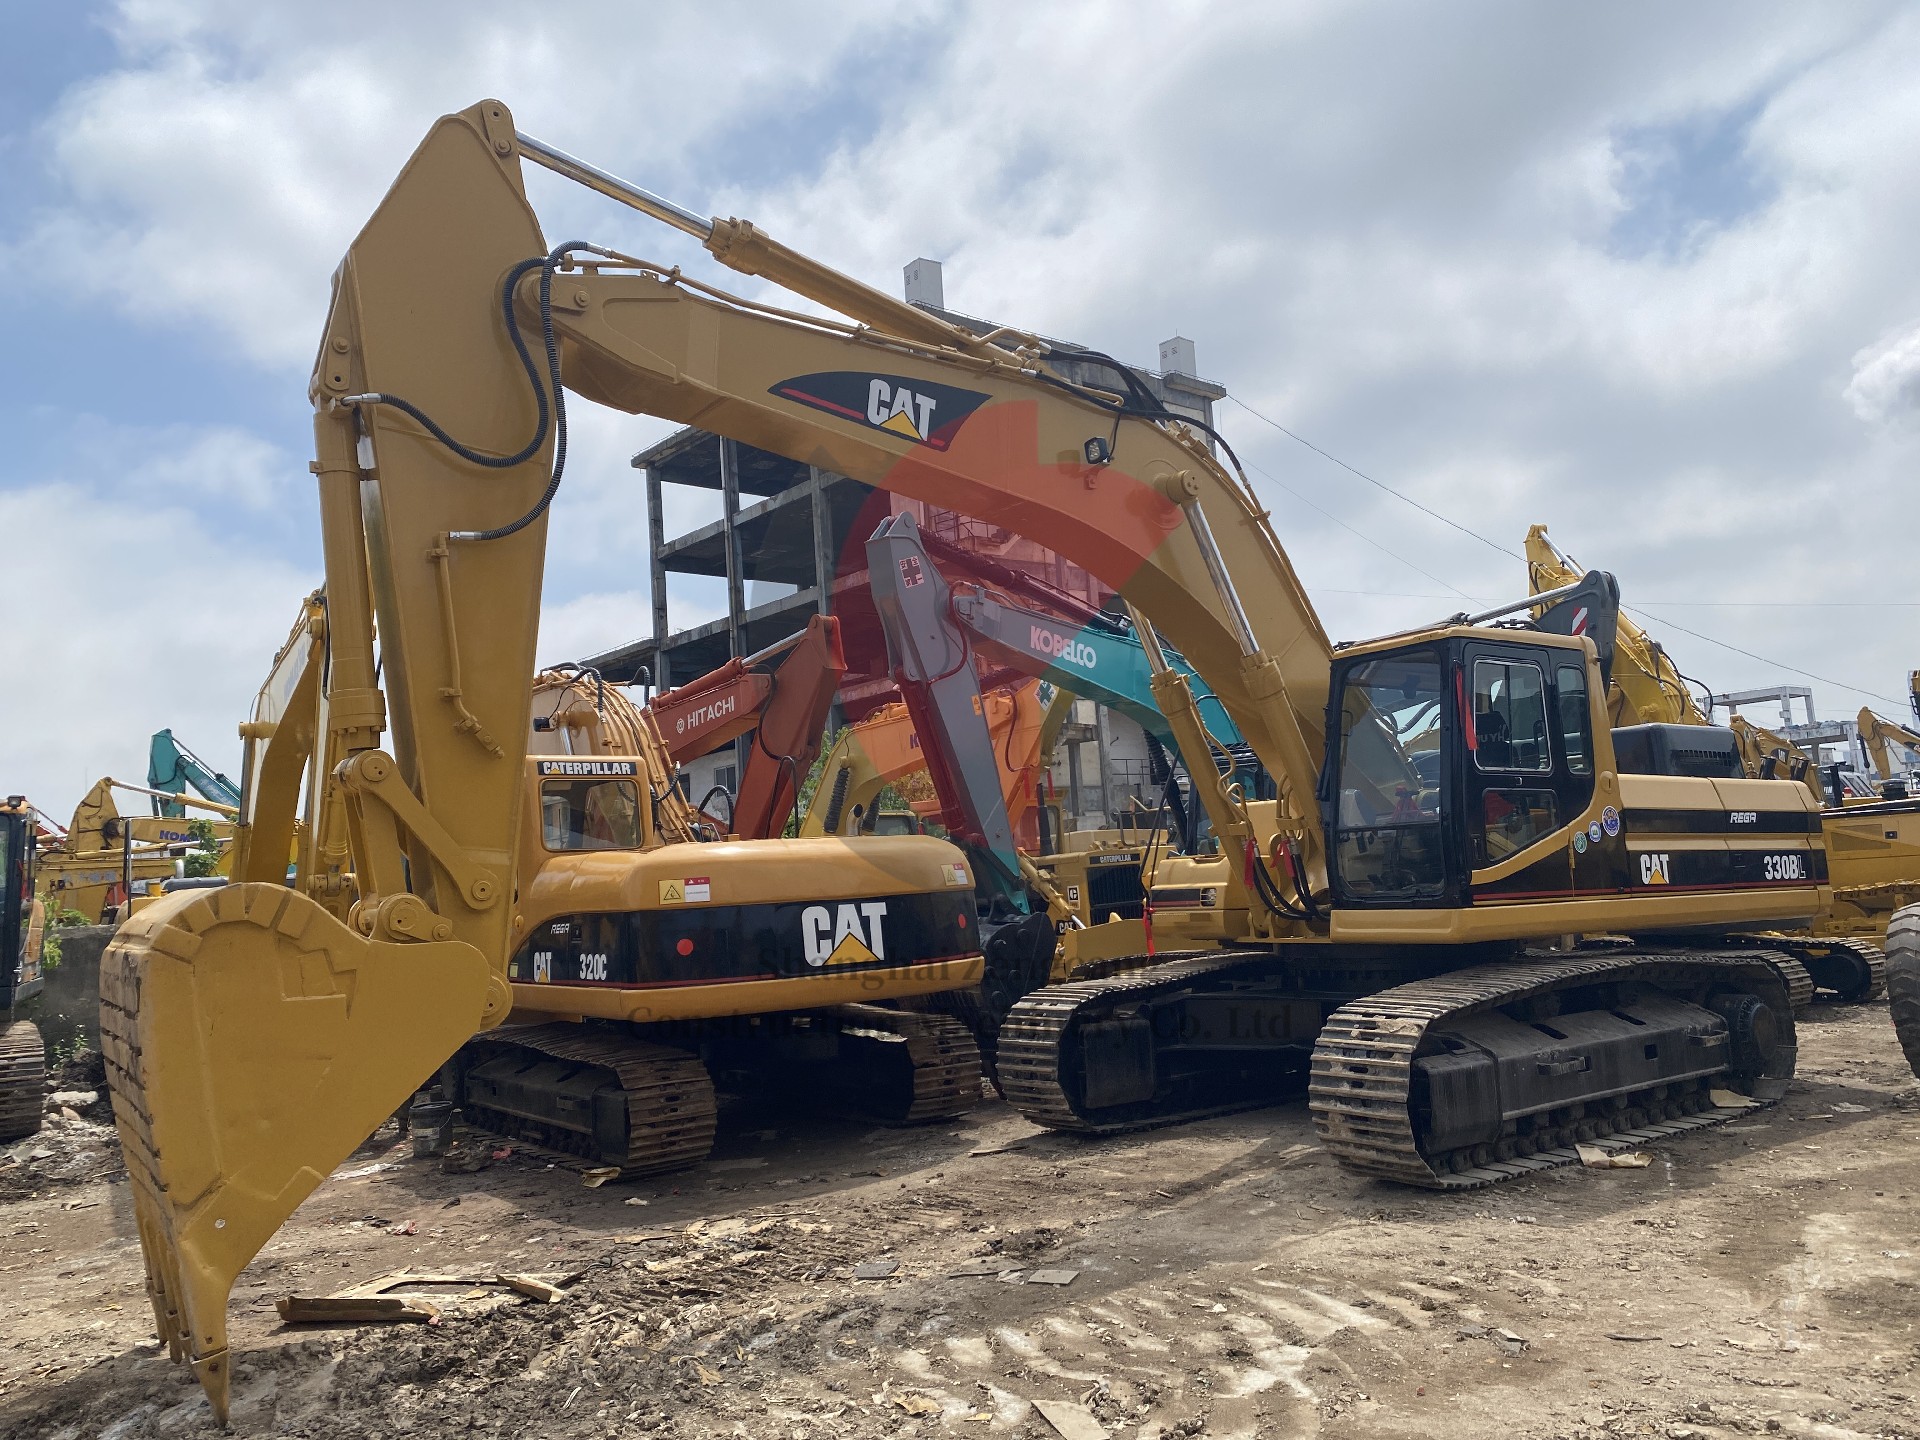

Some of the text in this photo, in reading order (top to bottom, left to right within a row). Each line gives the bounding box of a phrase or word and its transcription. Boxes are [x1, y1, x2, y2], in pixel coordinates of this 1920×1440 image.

[867, 378, 937, 442] CAT
[1031, 625, 1097, 669] KOBELCO
[687, 695, 735, 730] HITACHI
[542, 761, 631, 775] CATERPILLAR
[1730, 812, 1757, 824] REGA
[1099, 853, 1132, 864] CATERPILLAR
[1640, 853, 1670, 885] CAT
[801, 901, 888, 967] CAT
[533, 951, 552, 983] CAT
[579, 953, 607, 980] 320C
